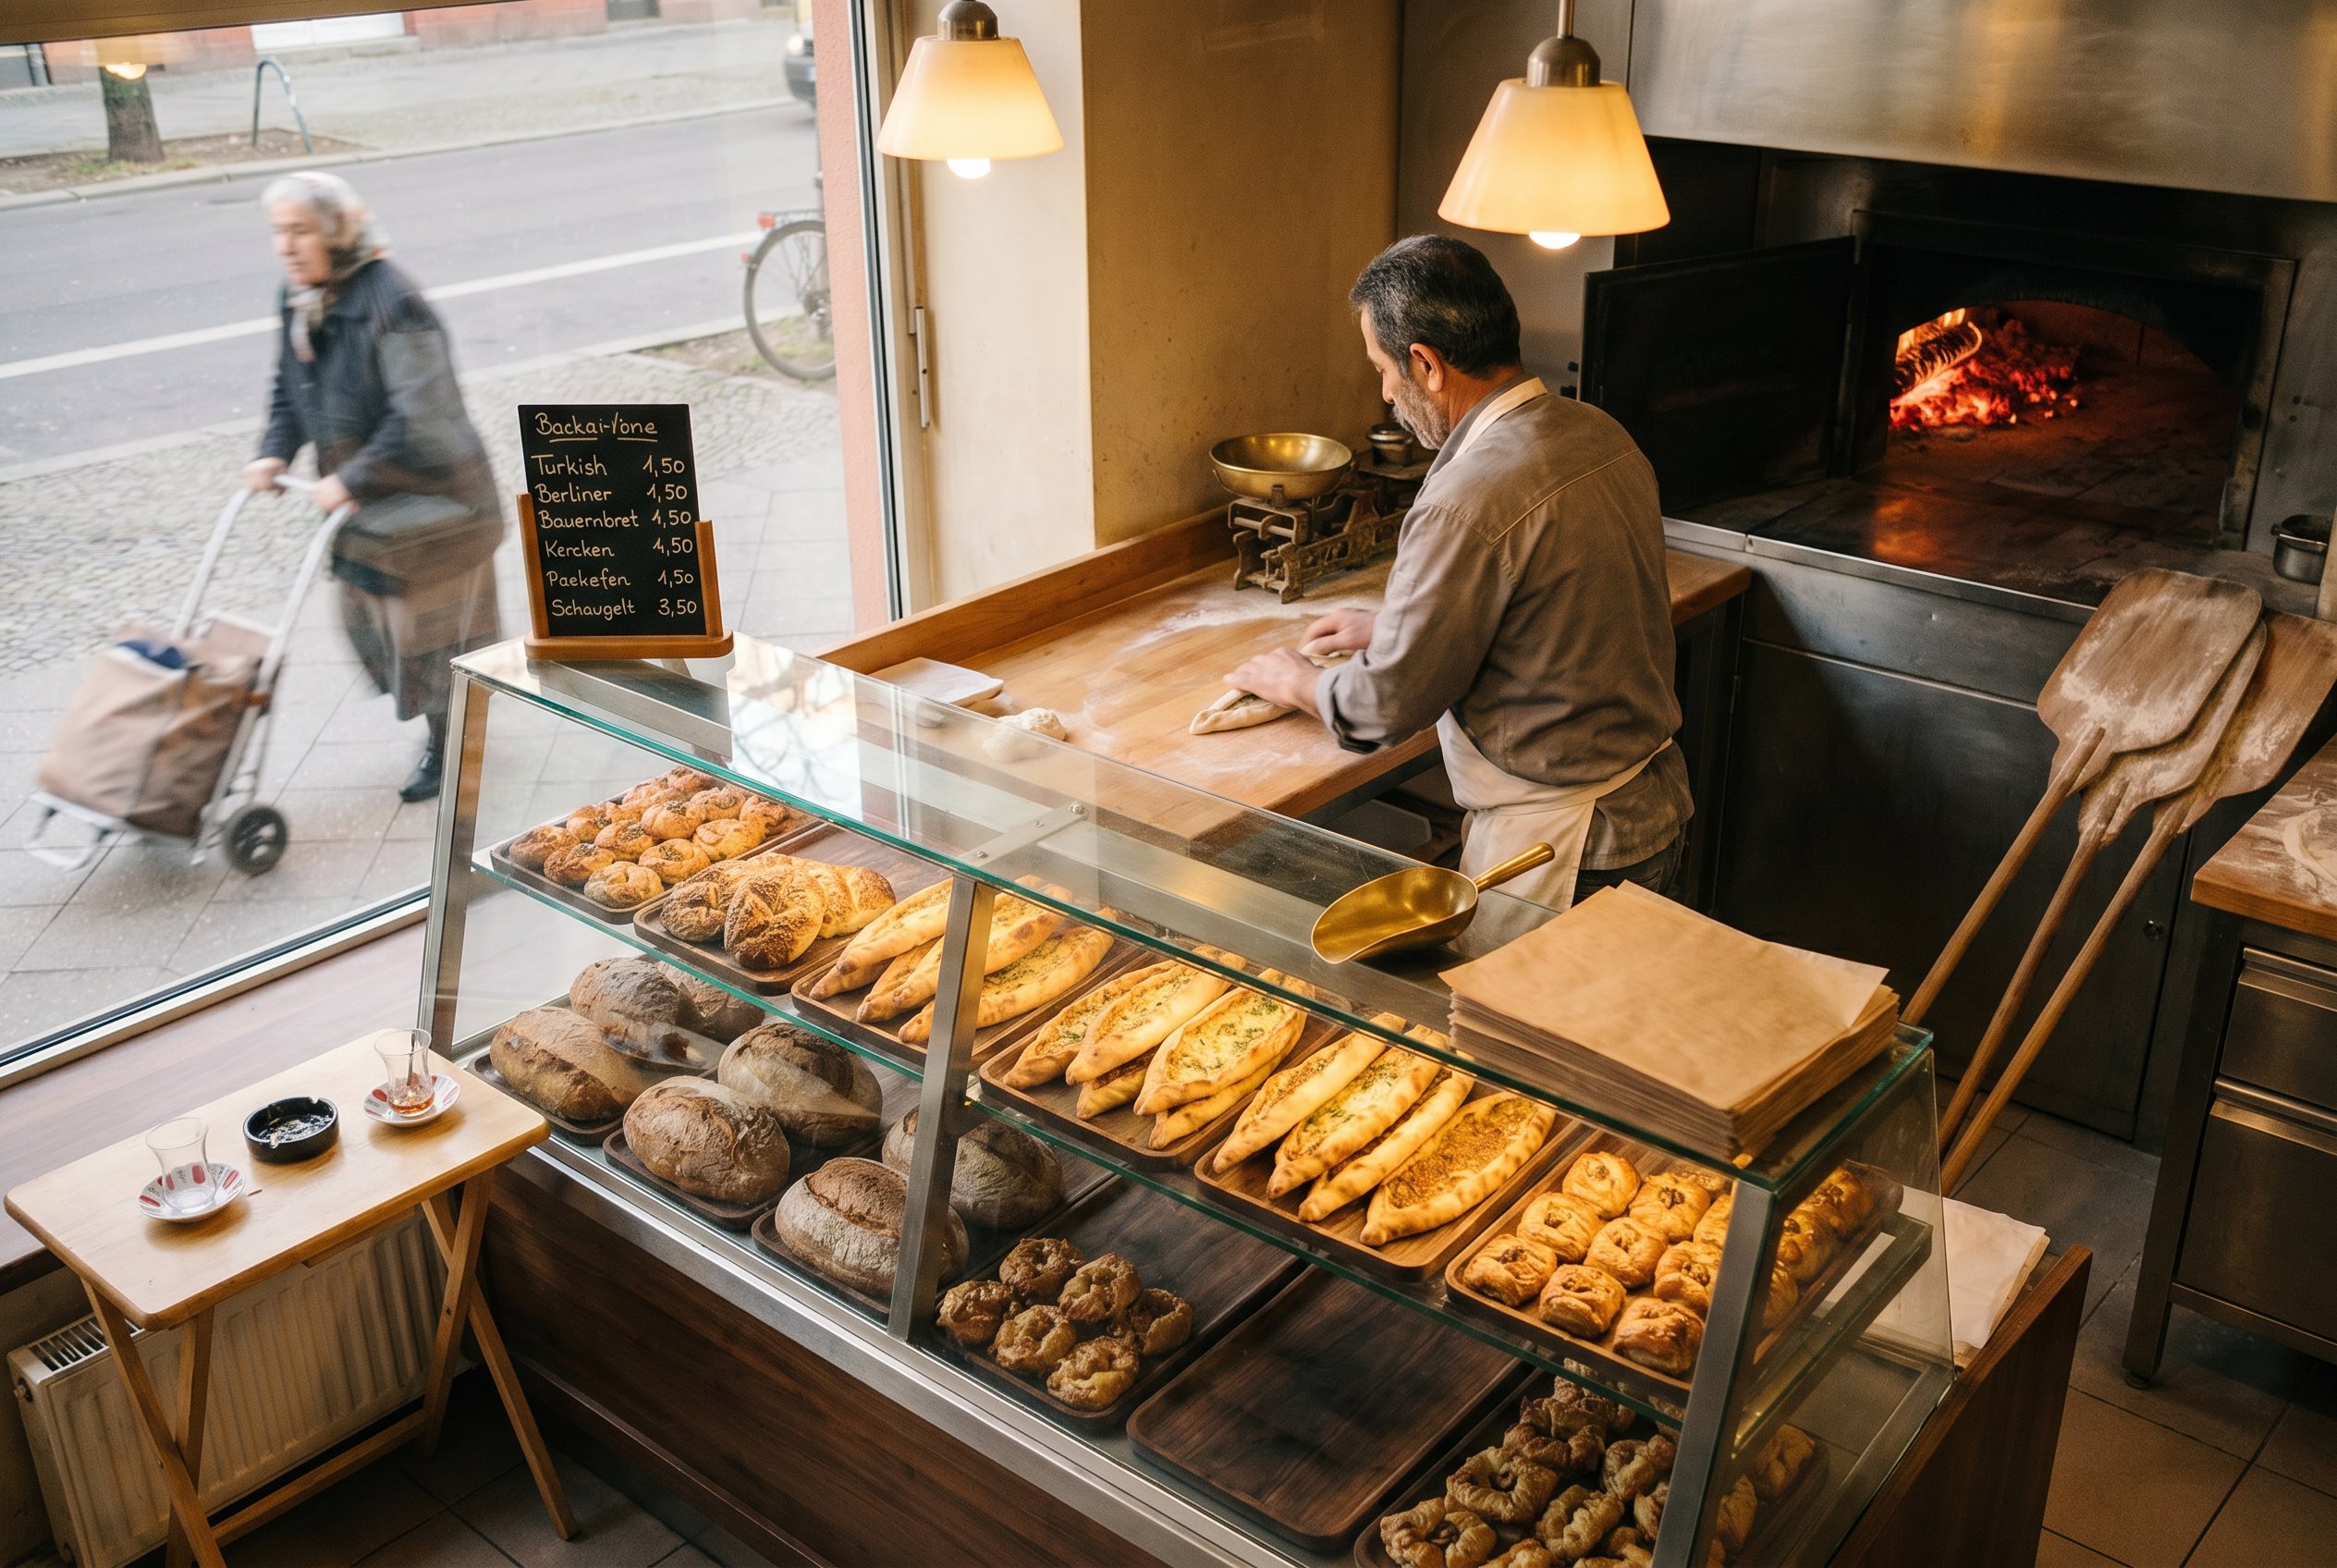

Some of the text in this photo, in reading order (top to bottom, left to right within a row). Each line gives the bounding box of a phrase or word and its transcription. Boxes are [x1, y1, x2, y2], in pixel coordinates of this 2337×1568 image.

[531, 454, 684, 477] Turkish 1,50
[535, 483, 687, 503] Berliner 1,50
[538, 509, 639, 528] Bauernbret
[545, 540, 615, 557] Kercken
[658, 570, 693, 587] 1,50
[553, 598, 696, 620] Schaugelt 3,50
